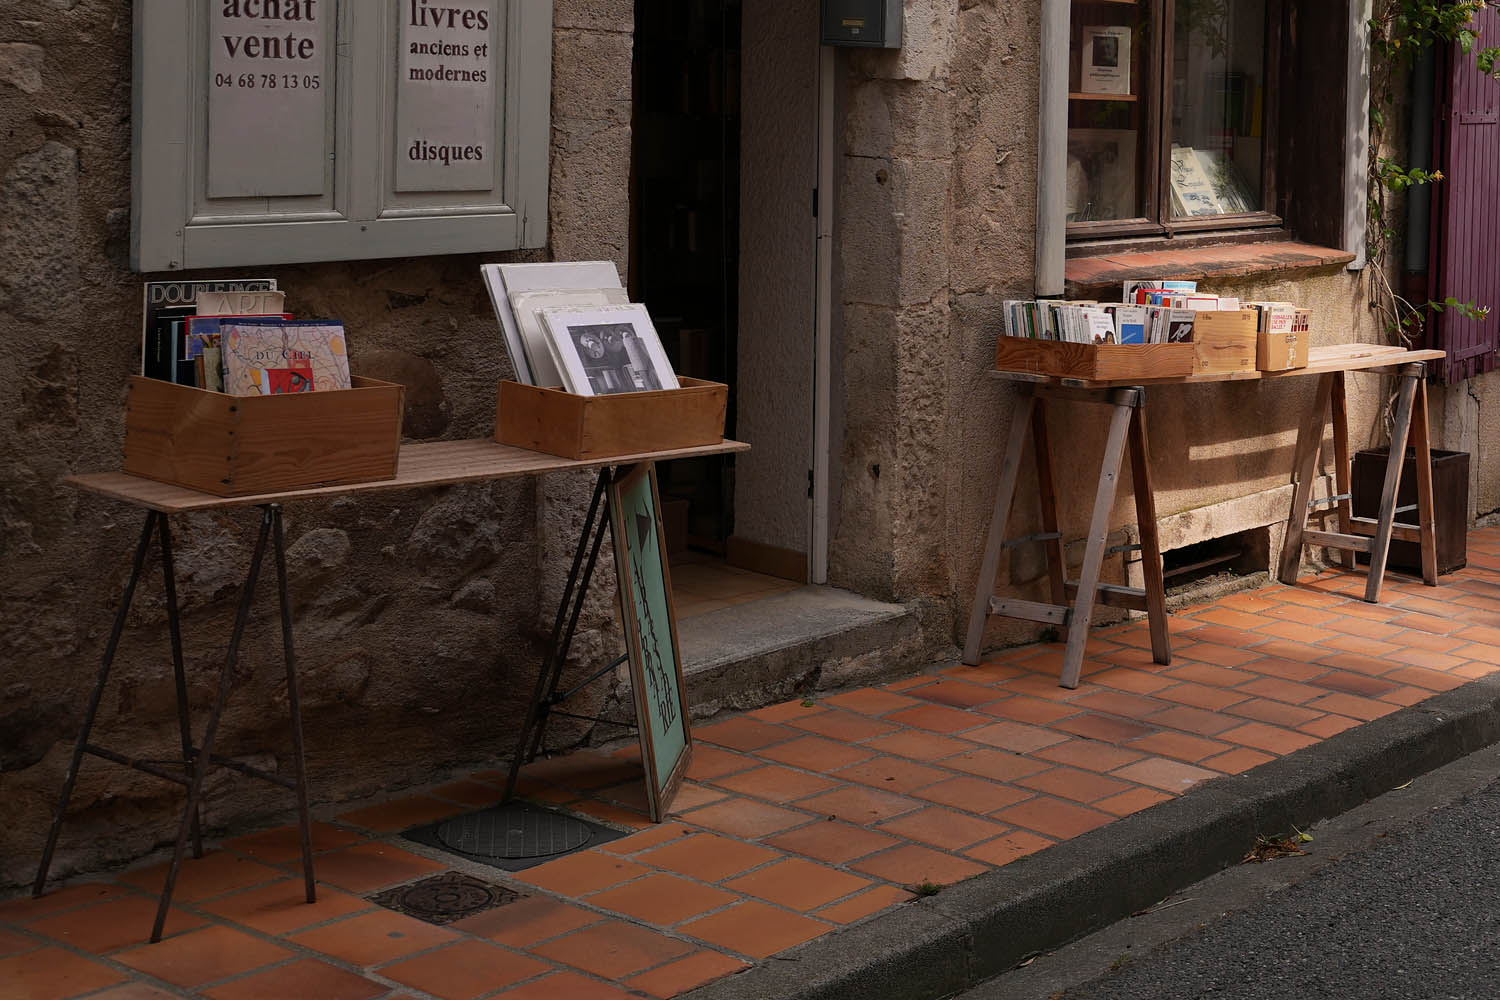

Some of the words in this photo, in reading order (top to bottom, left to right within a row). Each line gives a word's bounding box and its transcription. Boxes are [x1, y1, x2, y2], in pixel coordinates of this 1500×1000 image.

[222, 31, 315, 60] vente
[410, 39, 469, 56] anciens
[474, 41, 488, 58] et
[215, 72, 233, 88] 04
[238, 72, 255, 89] 68
[261, 73, 277, 89] 78
[282, 73, 298, 89] 13
[303, 73, 320, 89] 05
[409, 64, 487, 83] modernes
[408, 140, 483, 166] disques
[256, 351, 275, 361] DU
